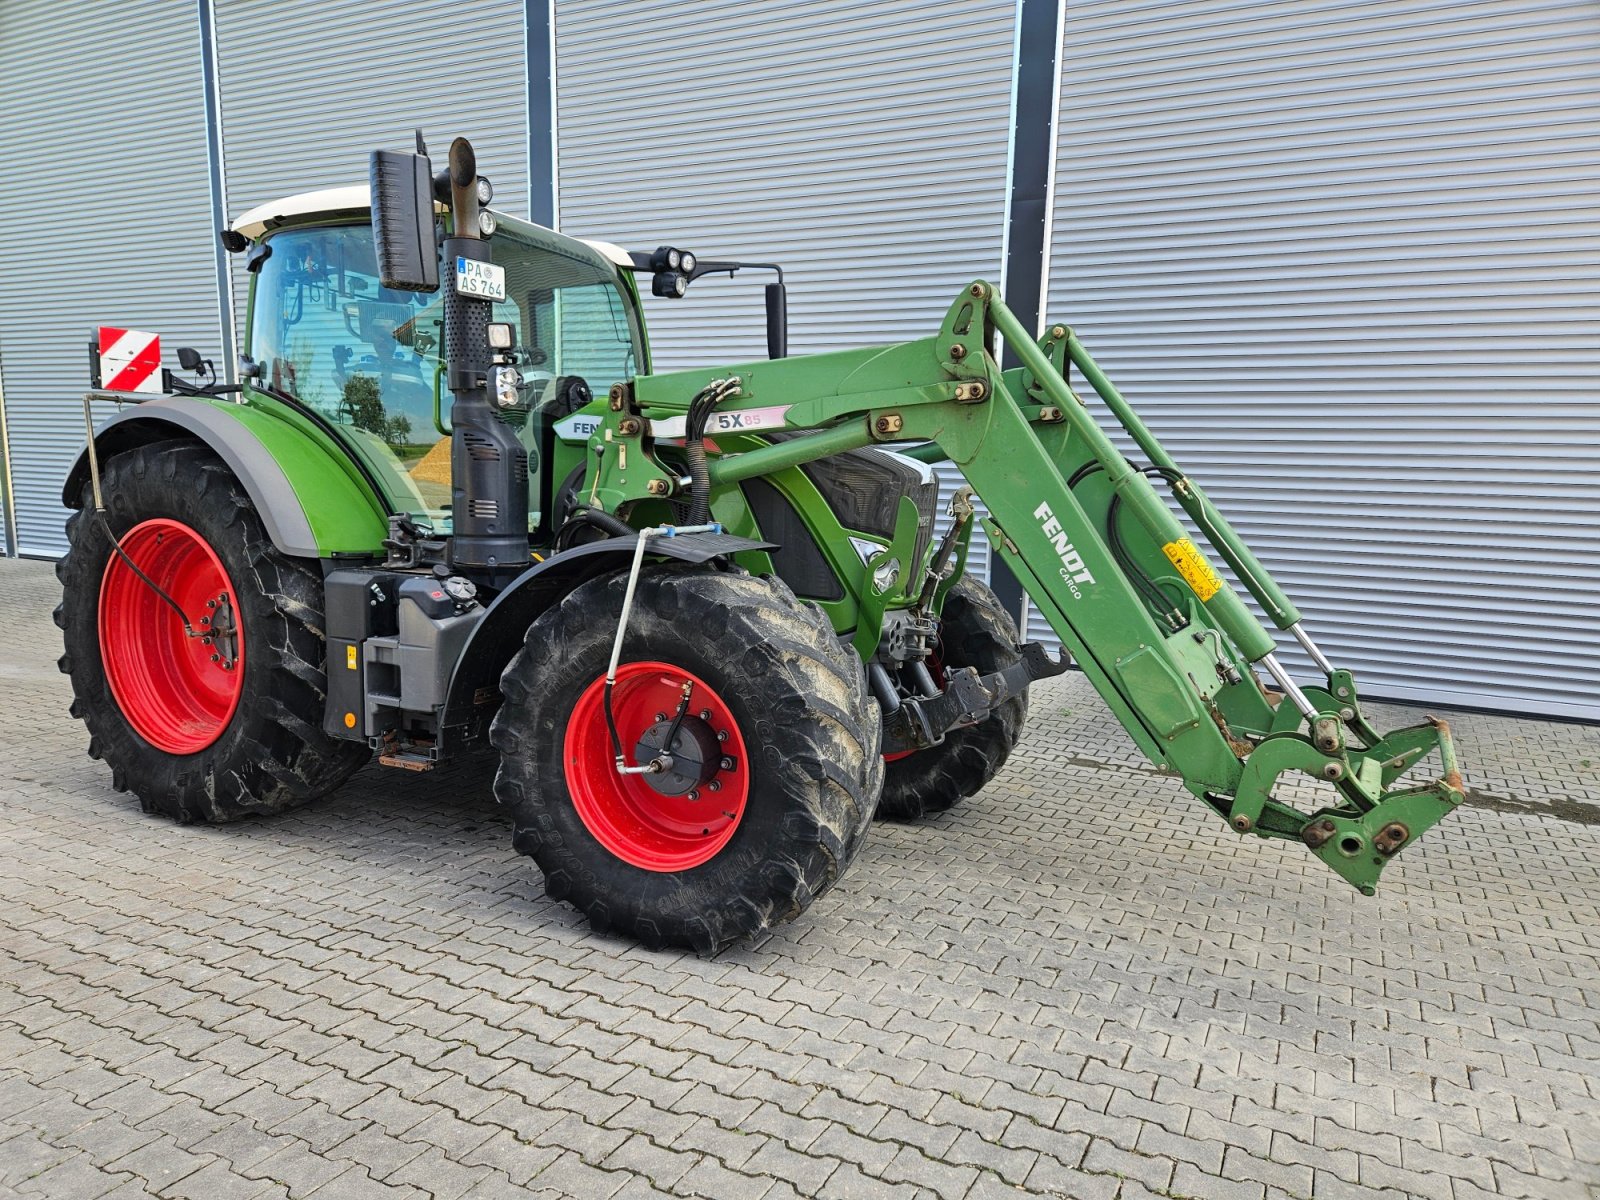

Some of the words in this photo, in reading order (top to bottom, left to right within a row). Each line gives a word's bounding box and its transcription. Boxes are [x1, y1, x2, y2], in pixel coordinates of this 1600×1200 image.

[466, 261, 482, 278] PA
[461, 276, 477, 292] AS
[480, 280, 502, 297] 764
[1033, 500, 1096, 586] FENDT
[1058, 568, 1082, 600] CARGO
